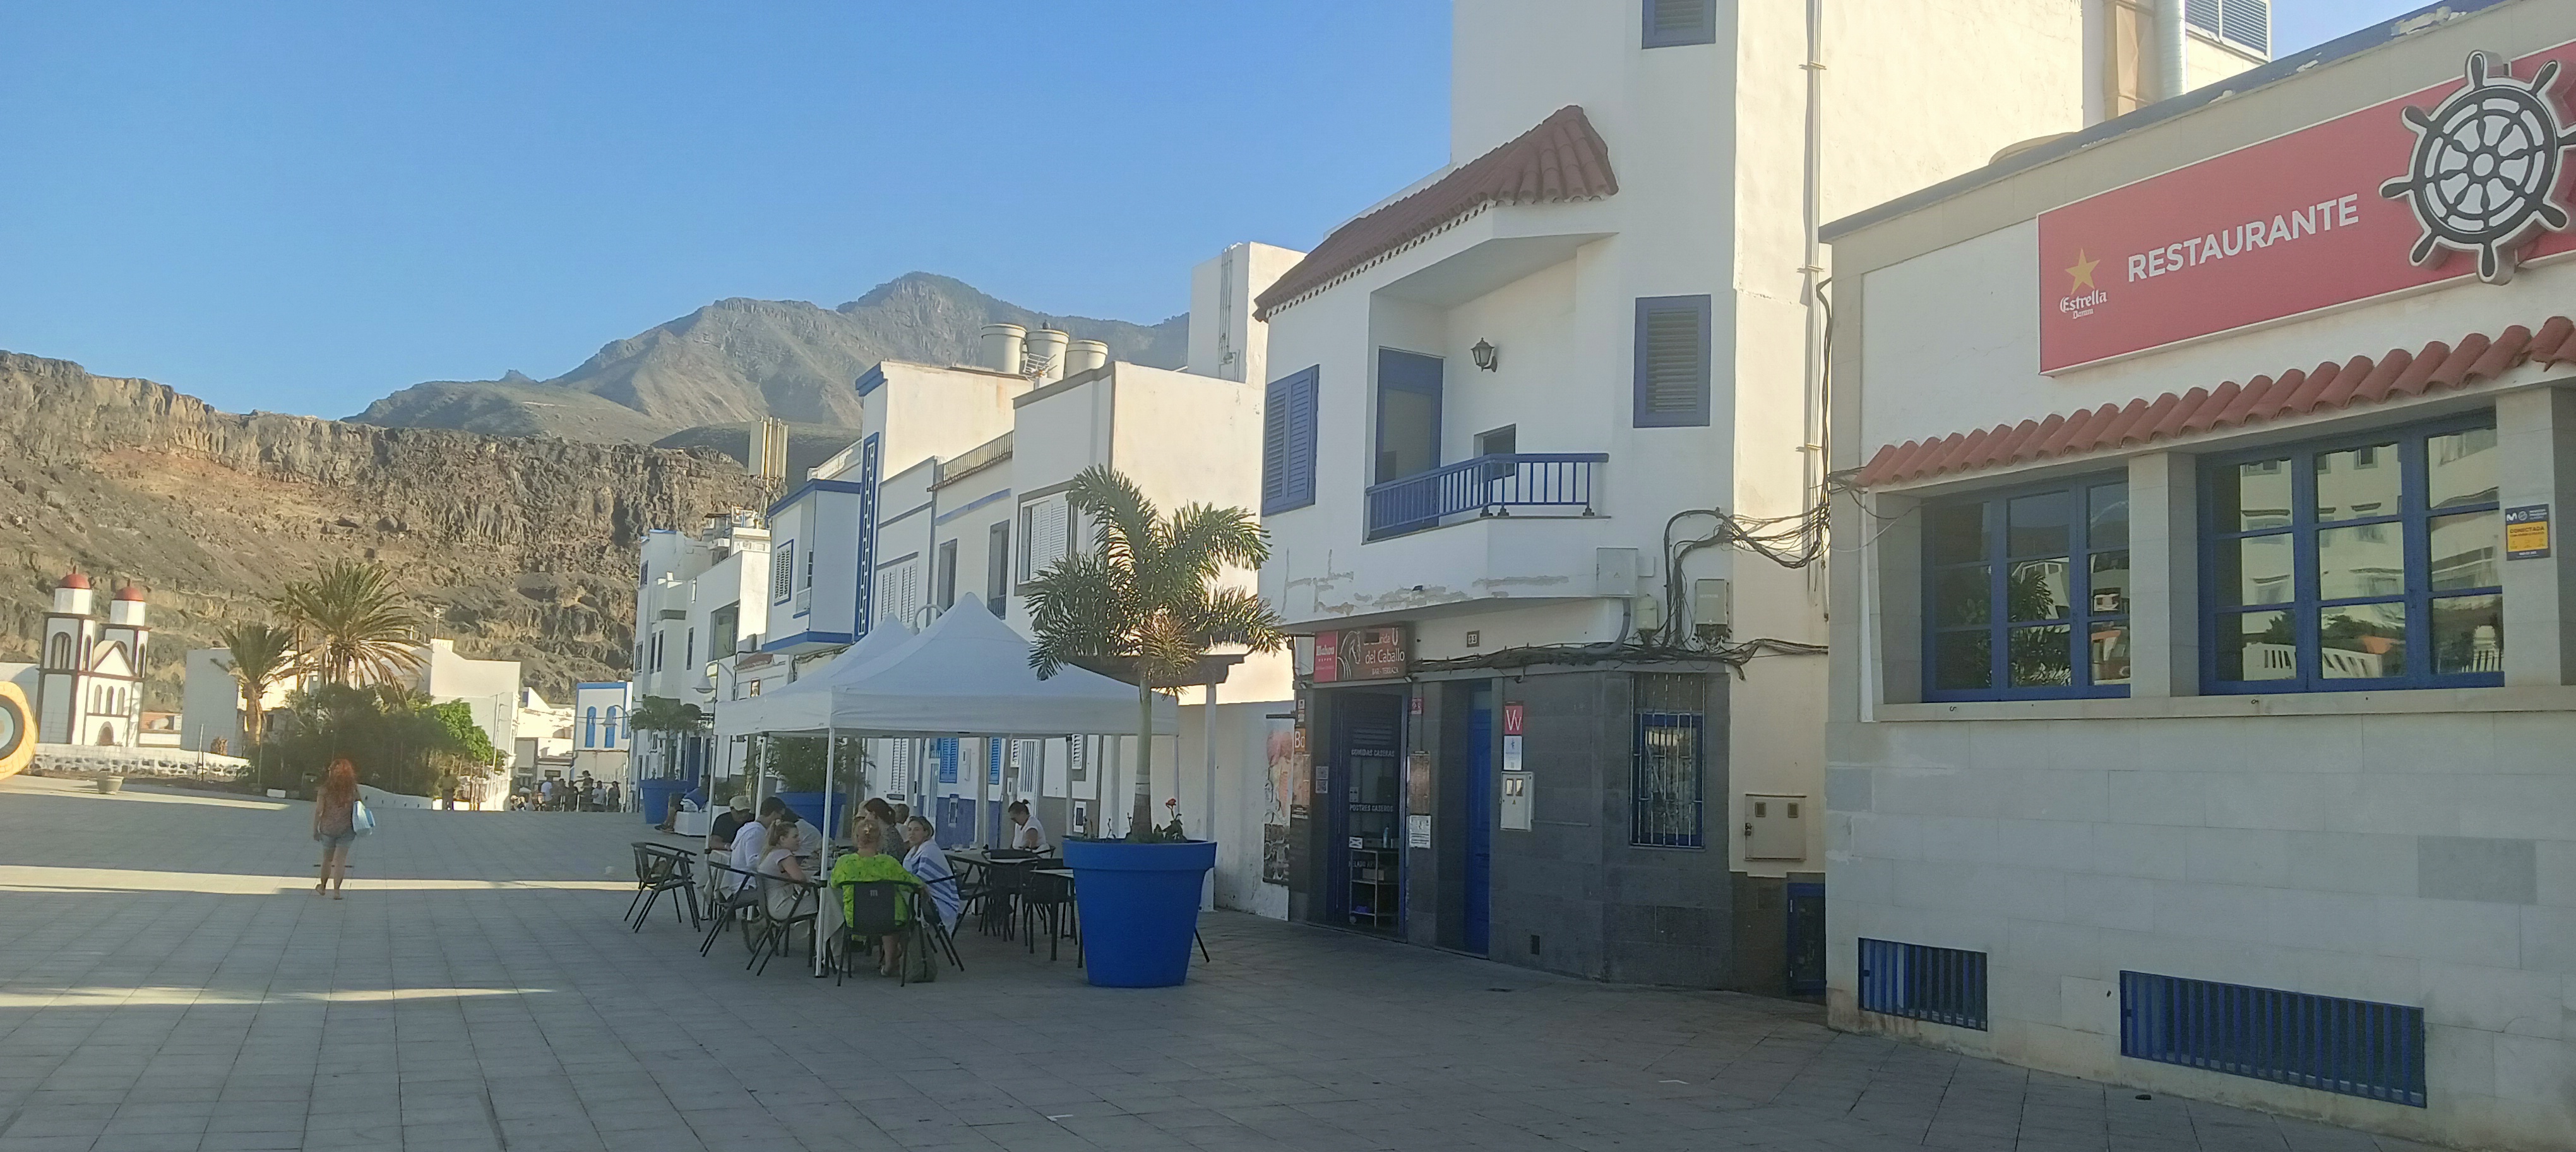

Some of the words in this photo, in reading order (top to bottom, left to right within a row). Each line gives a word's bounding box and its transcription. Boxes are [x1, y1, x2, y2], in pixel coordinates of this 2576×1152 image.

[2128, 193, 2359, 283] RESTAURANTE
[2060, 289, 2108, 313] Estrella
[1365, 649, 1376, 664] del
[1377, 647, 1405, 663] Caballo
